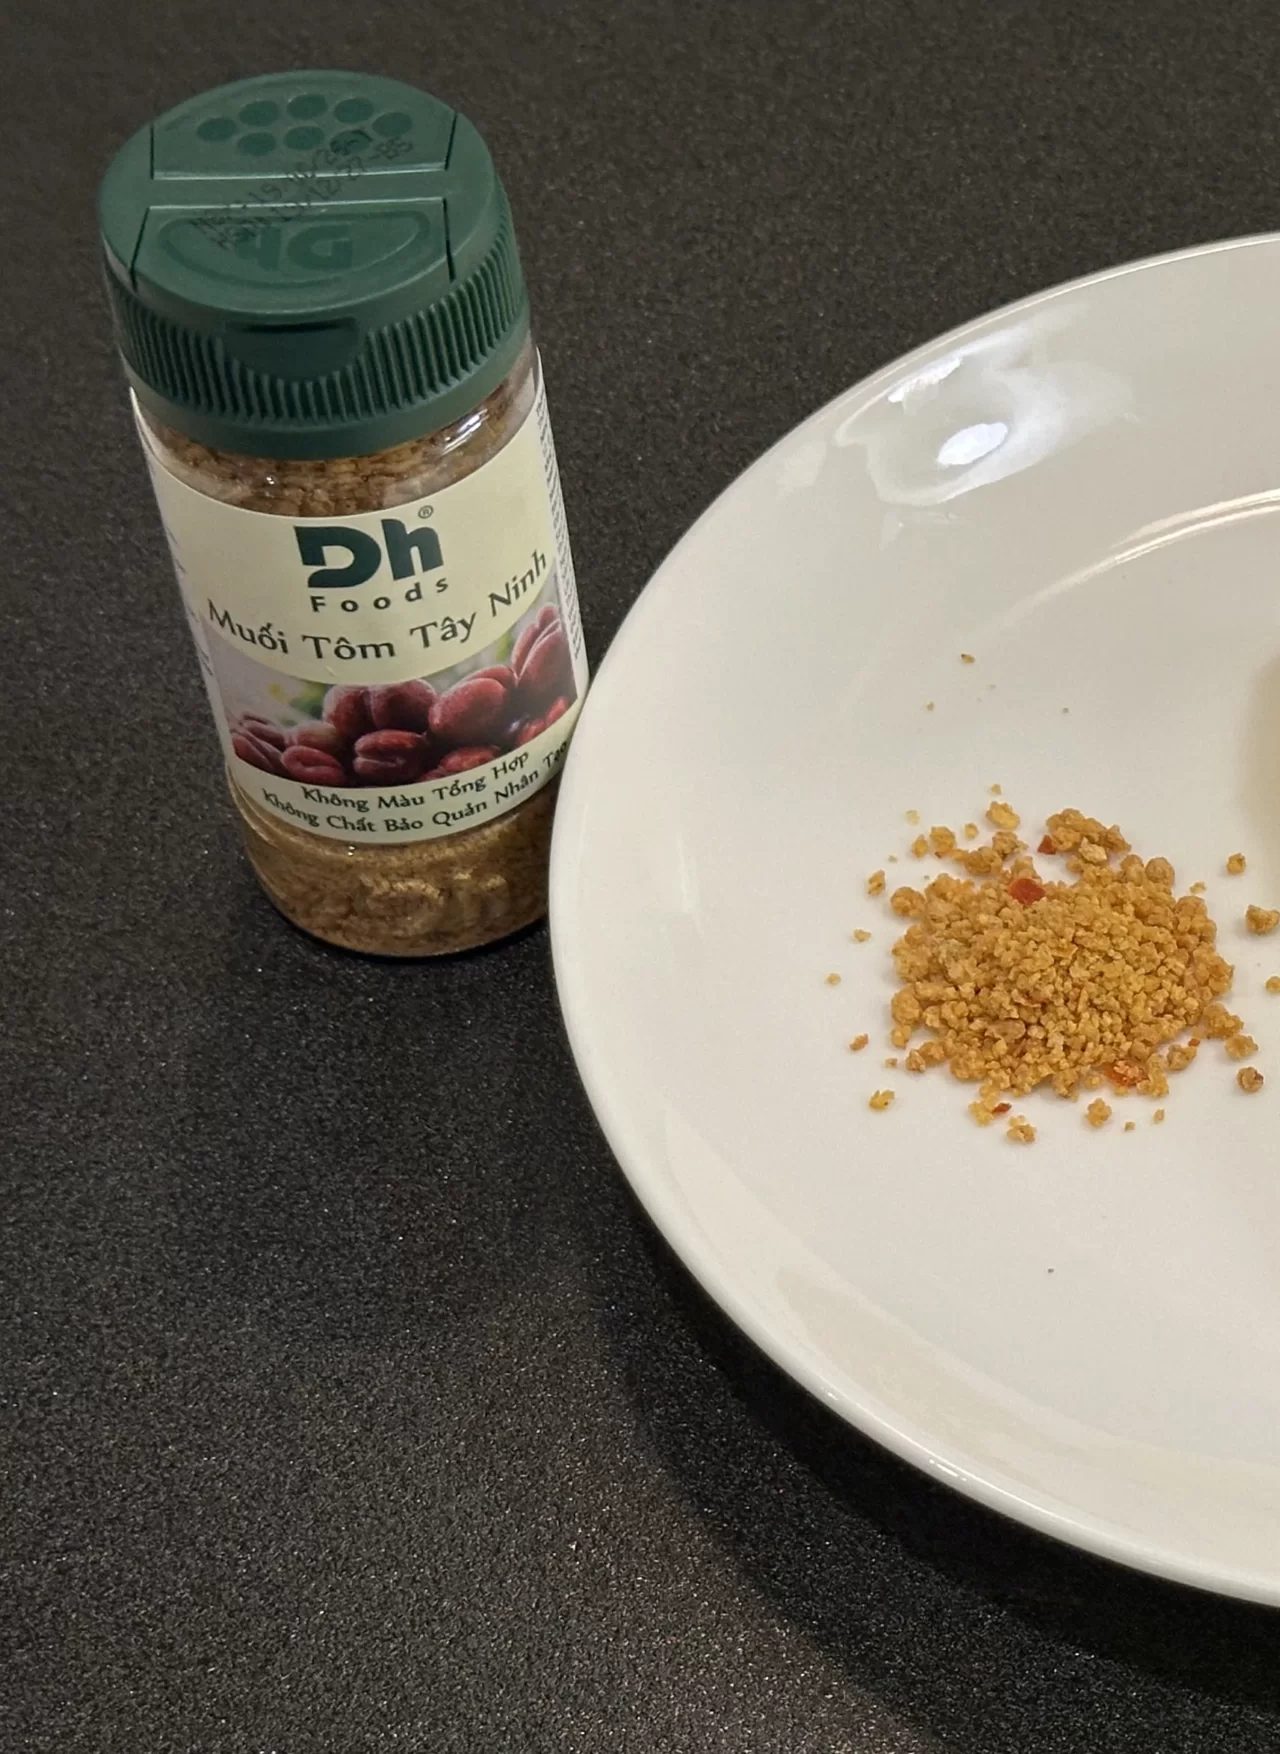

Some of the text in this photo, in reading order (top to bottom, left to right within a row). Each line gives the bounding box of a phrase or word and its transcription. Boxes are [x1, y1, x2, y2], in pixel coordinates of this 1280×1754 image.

[293, 518, 444, 589] Dh
[207, 598, 289, 654] Muối
[301, 634, 396, 660] Tôm
[409, 611, 477, 649] Tây
[487, 549, 547, 617] Ninh
[310, 578, 448, 613] Foods
[262, 788, 320, 828] Không
[326, 815, 377, 832] Chất
[384, 818, 424, 832] Bảo
[432, 801, 488, 826] Quản
[494, 770, 539, 804] Nhân
[301, 752, 529, 813] Không Màu Tổng Hợp
